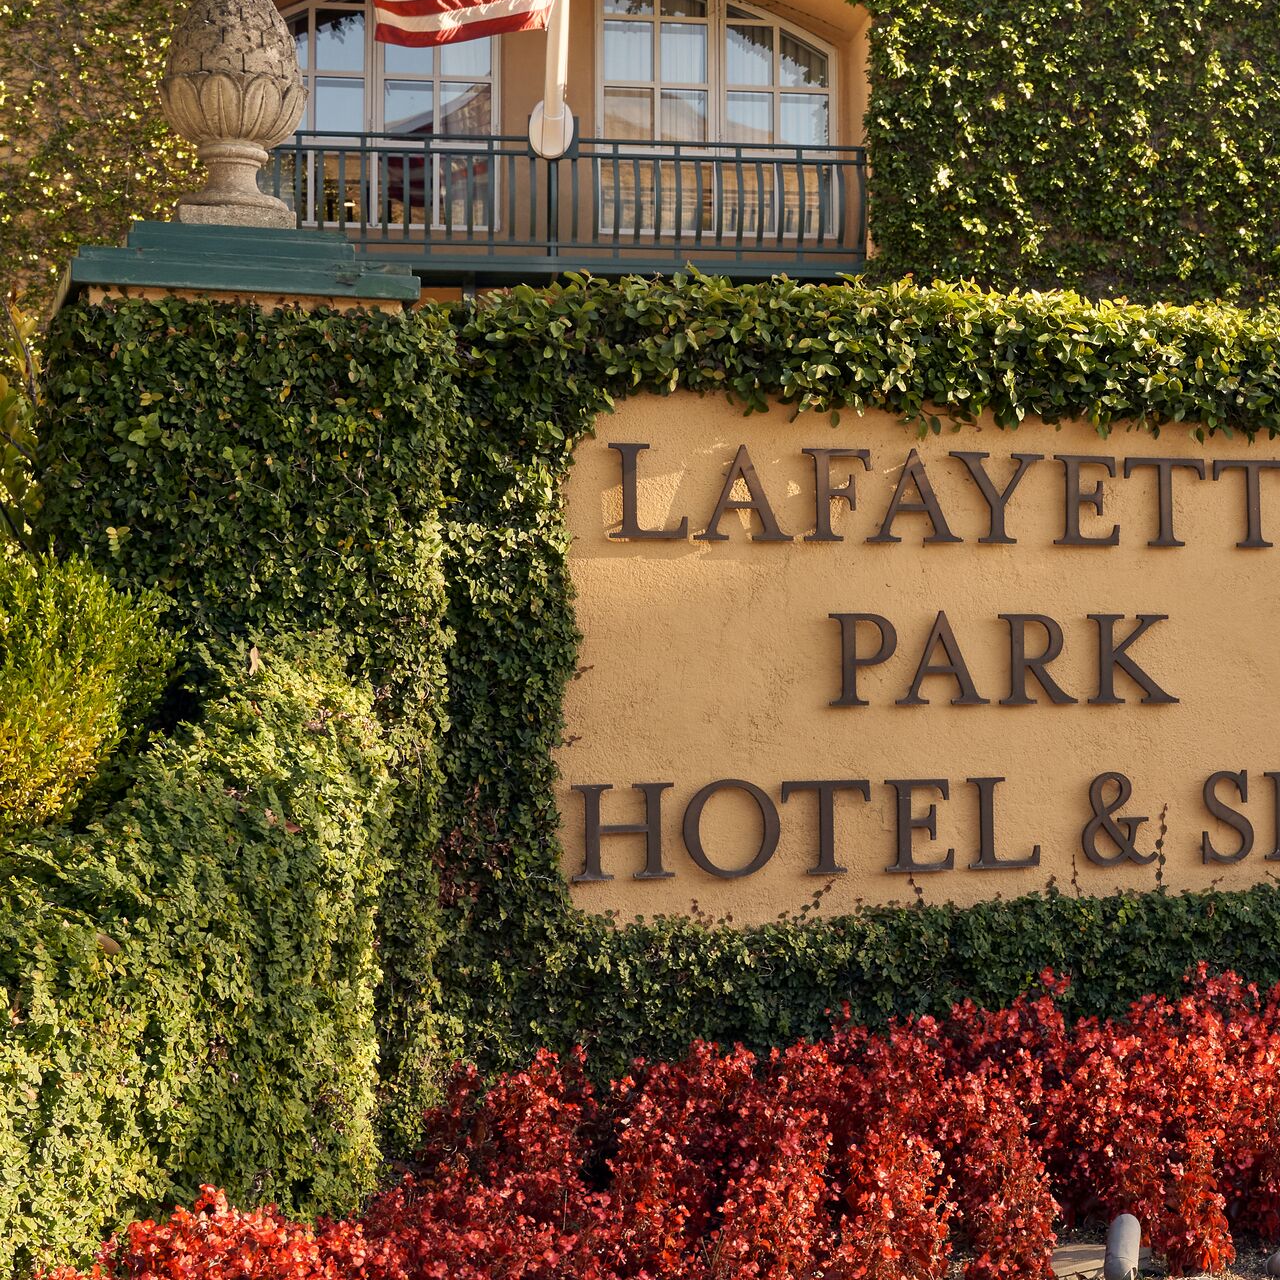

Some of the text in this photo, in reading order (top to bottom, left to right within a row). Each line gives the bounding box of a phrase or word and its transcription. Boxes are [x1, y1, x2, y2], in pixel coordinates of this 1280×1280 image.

[828, 609, 1180, 706] PARK
[570, 776, 1041, 883] HOTEL
[1081, 771, 1159, 868] &
